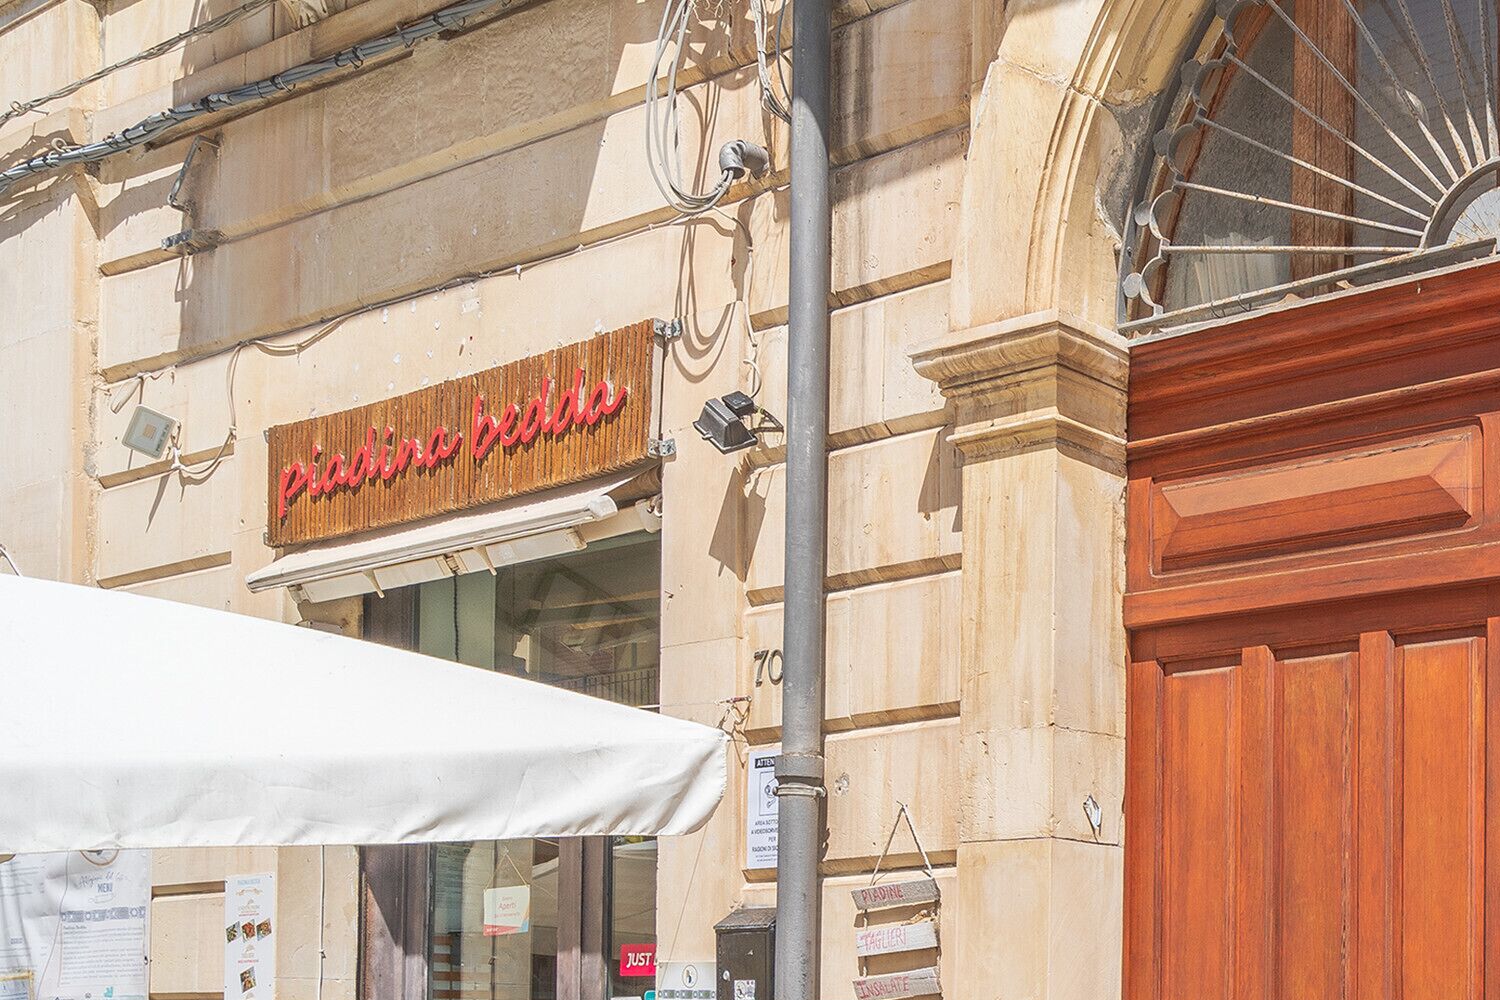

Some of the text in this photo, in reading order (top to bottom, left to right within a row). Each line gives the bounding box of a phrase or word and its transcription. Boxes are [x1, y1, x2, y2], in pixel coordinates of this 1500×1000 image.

[279, 367, 629, 518] piadina bedda
[754, 648, 784, 688] 70
[756, 758, 775, 768] ATTEN
[861, 884, 904, 904] PIADINE
[861, 927, 908, 952] TAGLIERI
[626, 952, 653, 969] JUST
[856, 975, 909, 999] INSALATE
